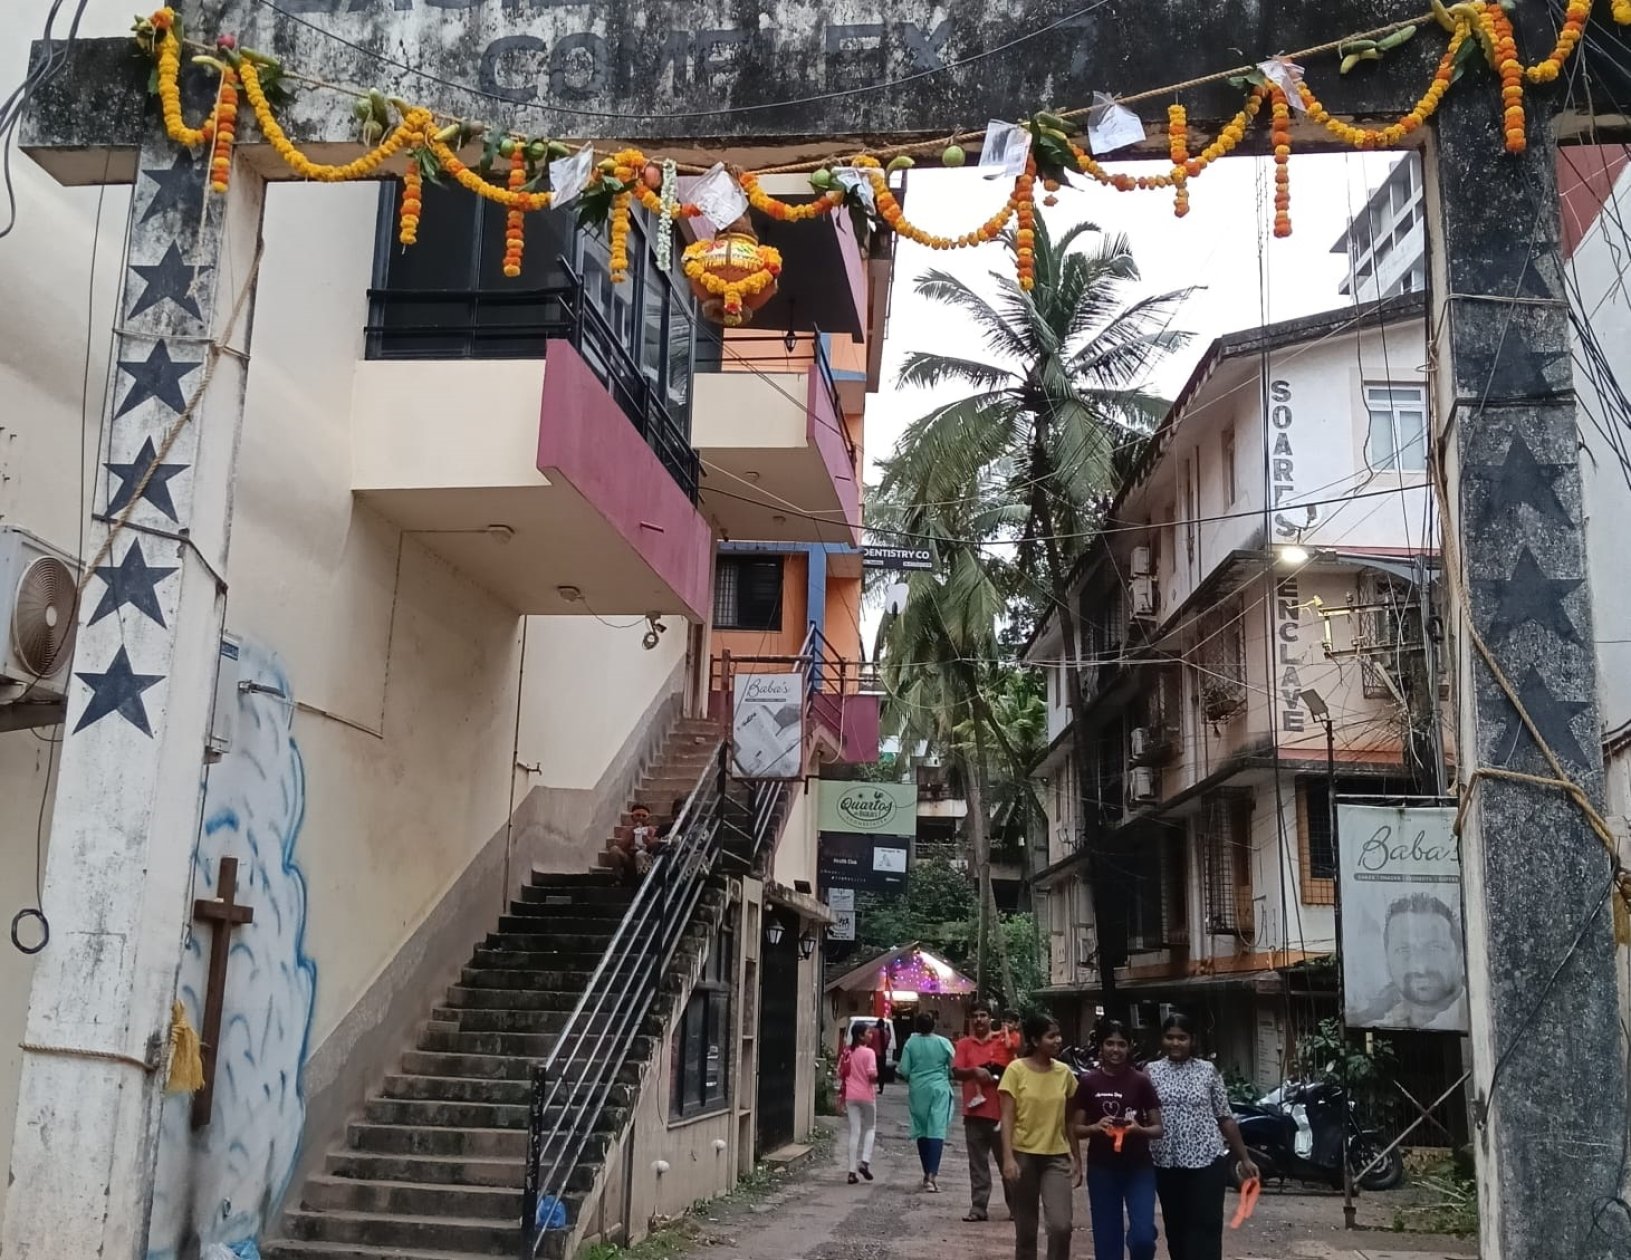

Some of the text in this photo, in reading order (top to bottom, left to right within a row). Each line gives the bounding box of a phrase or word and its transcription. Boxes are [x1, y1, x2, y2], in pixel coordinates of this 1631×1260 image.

[915, 550, 930, 560] CO
[1276, 576, 1304, 732] ENCLAVE
[746, 678, 790, 698] Baba's
[840, 797, 893, 815] Quartos
